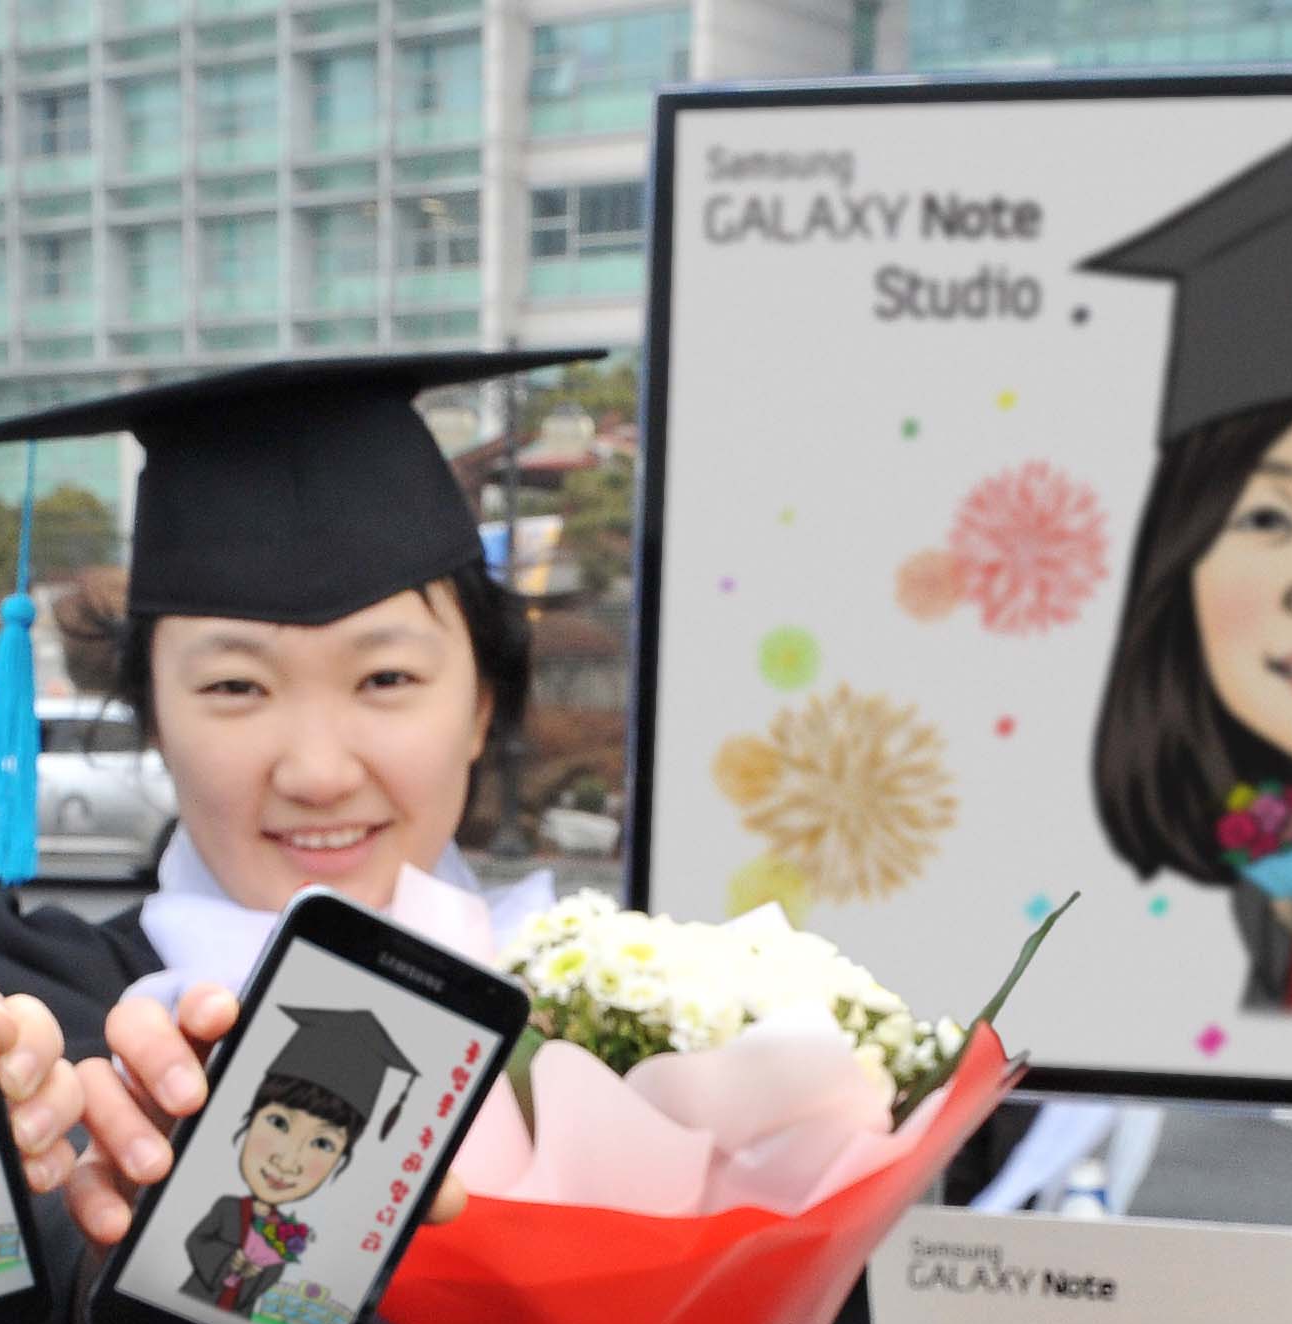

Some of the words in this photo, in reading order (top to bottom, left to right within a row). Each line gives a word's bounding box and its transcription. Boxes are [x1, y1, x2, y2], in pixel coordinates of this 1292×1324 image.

[707, 146, 855, 186] Samsung
[704, 195, 907, 244] GALAXY
[920, 194, 1043, 240] Note
[873, 264, 1043, 322] Studio
[908, 1261, 1035, 1295] GALAXY
[1040, 1268, 1117, 1301] Note
